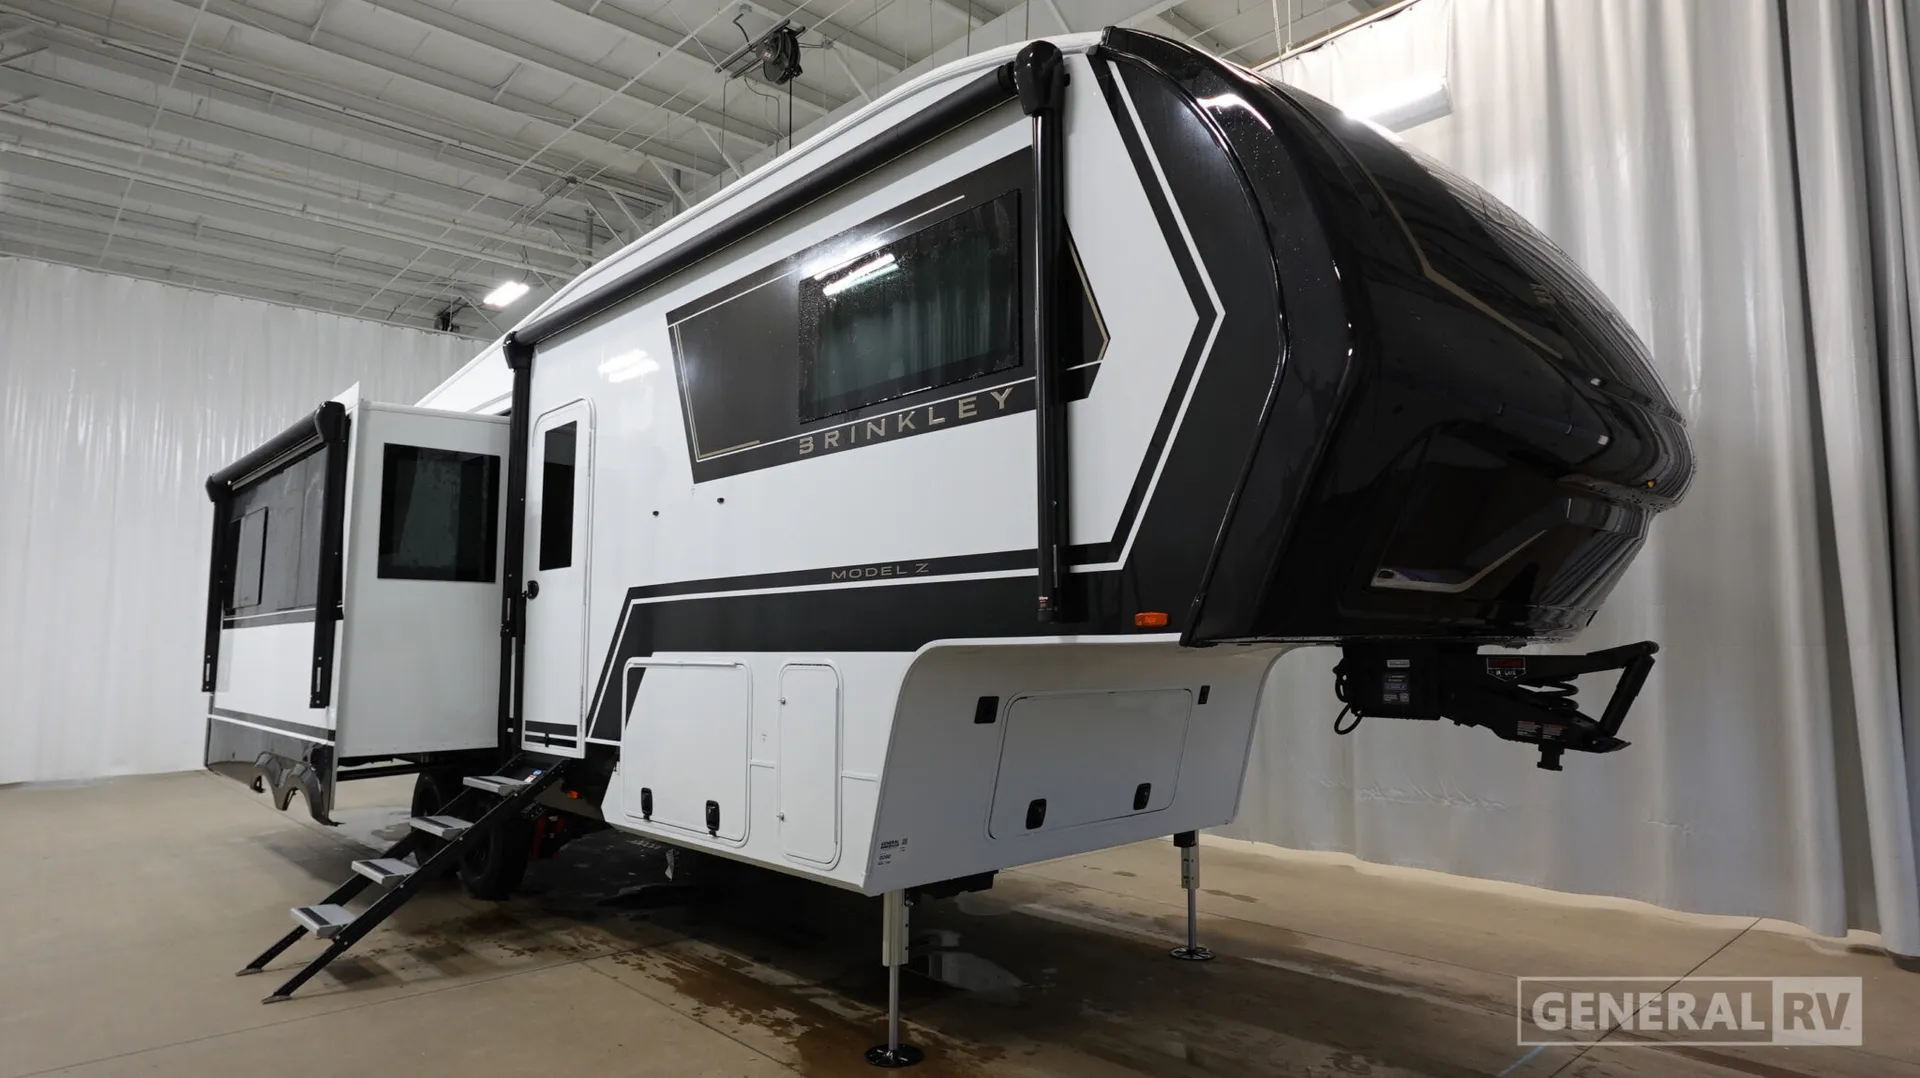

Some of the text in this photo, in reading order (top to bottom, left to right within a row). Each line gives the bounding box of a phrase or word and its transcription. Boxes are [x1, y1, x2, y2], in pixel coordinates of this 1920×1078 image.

[799, 387, 1014, 455] BRINKLEY
[831, 563, 930, 580] MODEL Z
